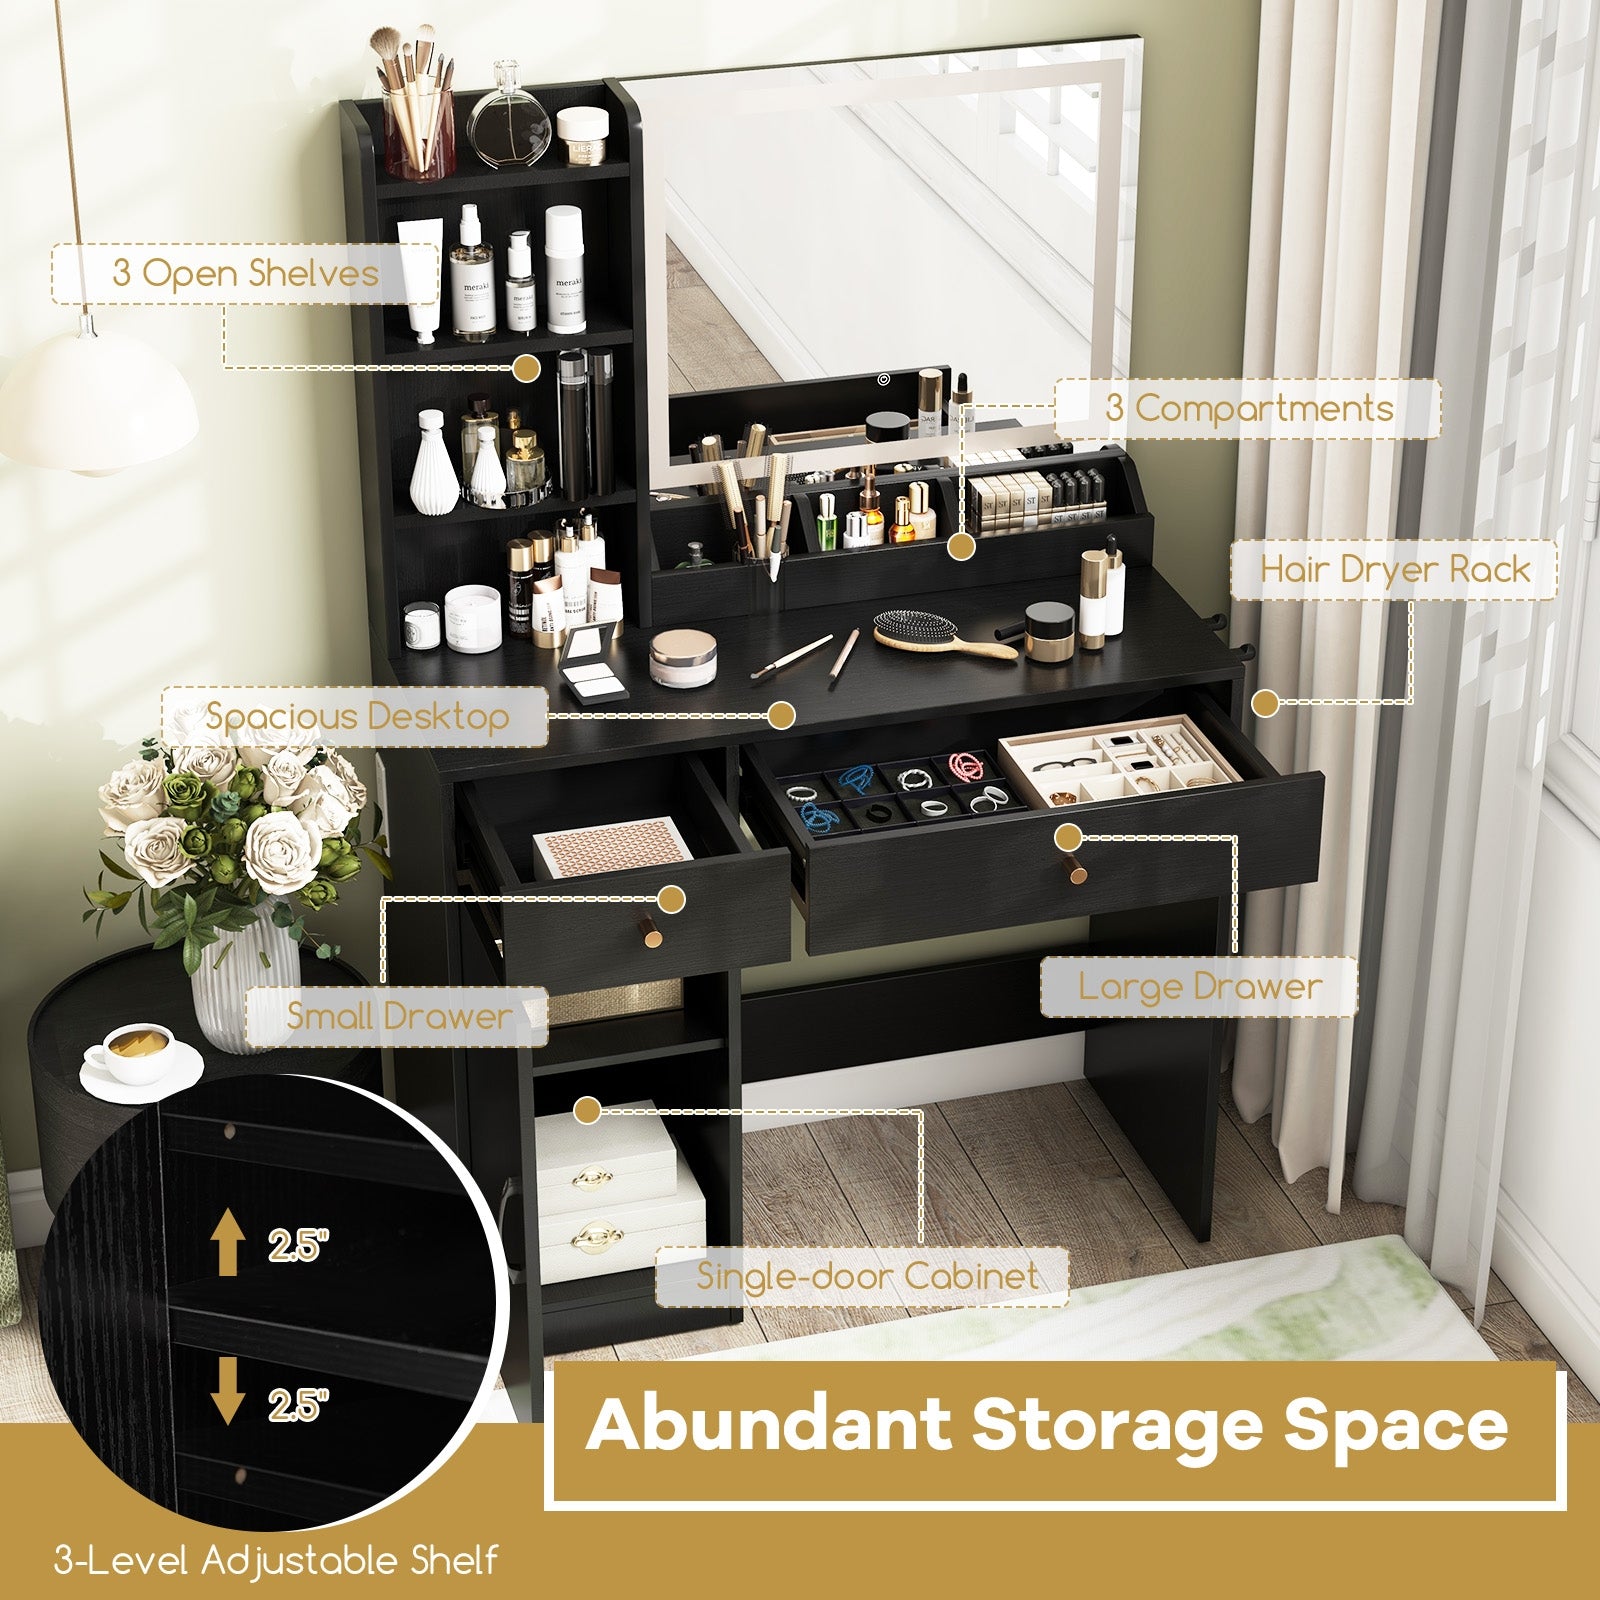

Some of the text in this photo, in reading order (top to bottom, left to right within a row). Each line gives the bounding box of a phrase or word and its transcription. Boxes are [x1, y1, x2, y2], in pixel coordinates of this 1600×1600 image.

[464, 281, 489, 291] meraki
[556, 277, 583, 287] meraki
[1012, 498, 1022, 506] ST
[1027, 496, 1036, 504] ST
[1041, 495, 1050, 503] ST
[984, 502, 993, 510] ST
[998, 500, 1008, 508] ST
[1067, 513, 1077, 521] ST
[1081, 511, 1091, 519] ST
[1095, 510, 1105, 518] ST
